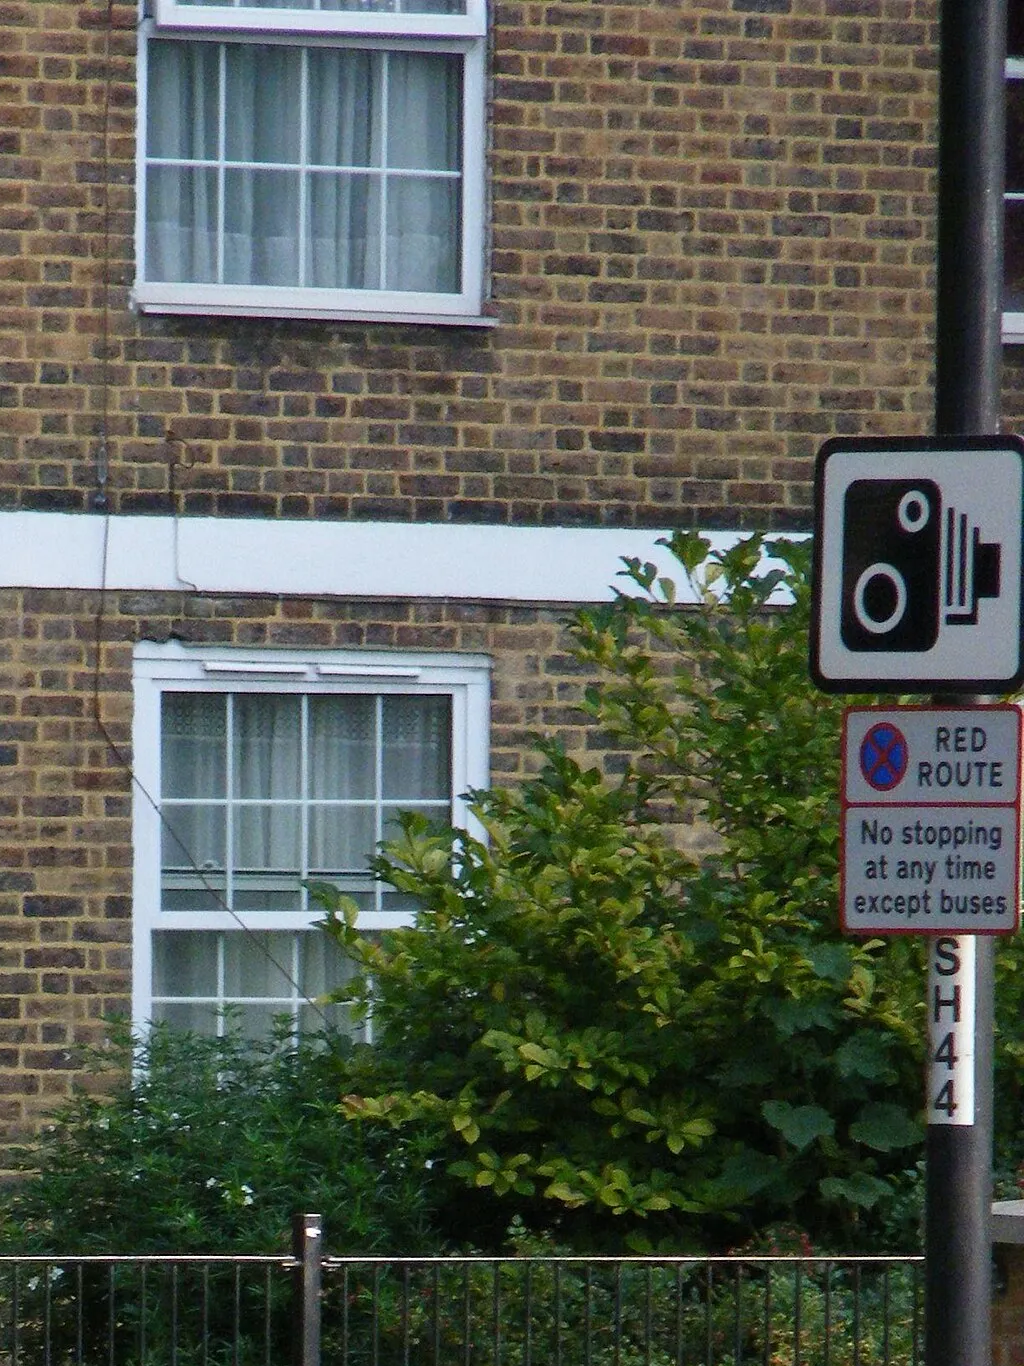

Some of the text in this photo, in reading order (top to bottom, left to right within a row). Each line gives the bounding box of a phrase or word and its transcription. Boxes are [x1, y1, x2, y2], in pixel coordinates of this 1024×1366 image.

[935, 726, 987, 753] RED
[918, 761, 1004, 788] ROUTE
[860, 820, 1003, 850] No stopping
[864, 855, 996, 884] at any time
[854, 890, 1007, 918] except buses
